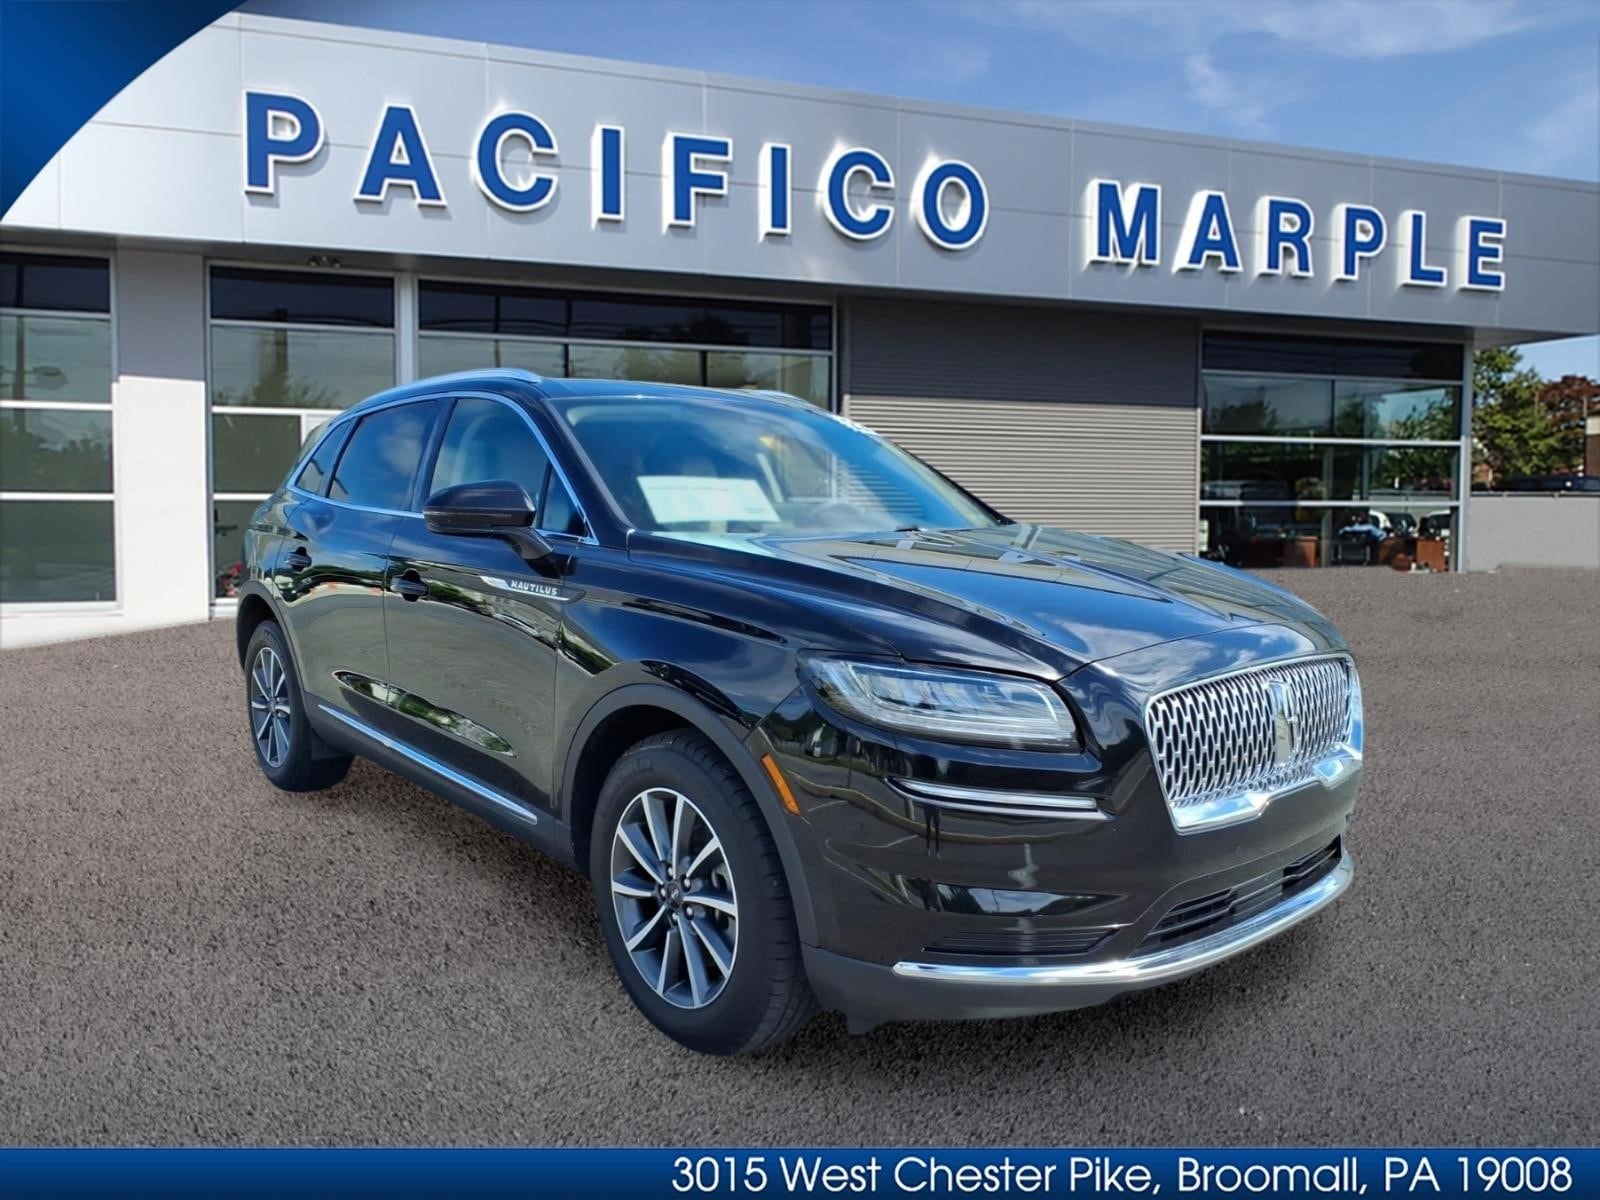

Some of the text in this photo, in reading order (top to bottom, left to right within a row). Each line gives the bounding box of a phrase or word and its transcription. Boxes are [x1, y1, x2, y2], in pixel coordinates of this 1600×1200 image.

[243, 90, 1507, 293] PACIFICO MARPLE
[511, 580, 558, 595] NAUTILUS
